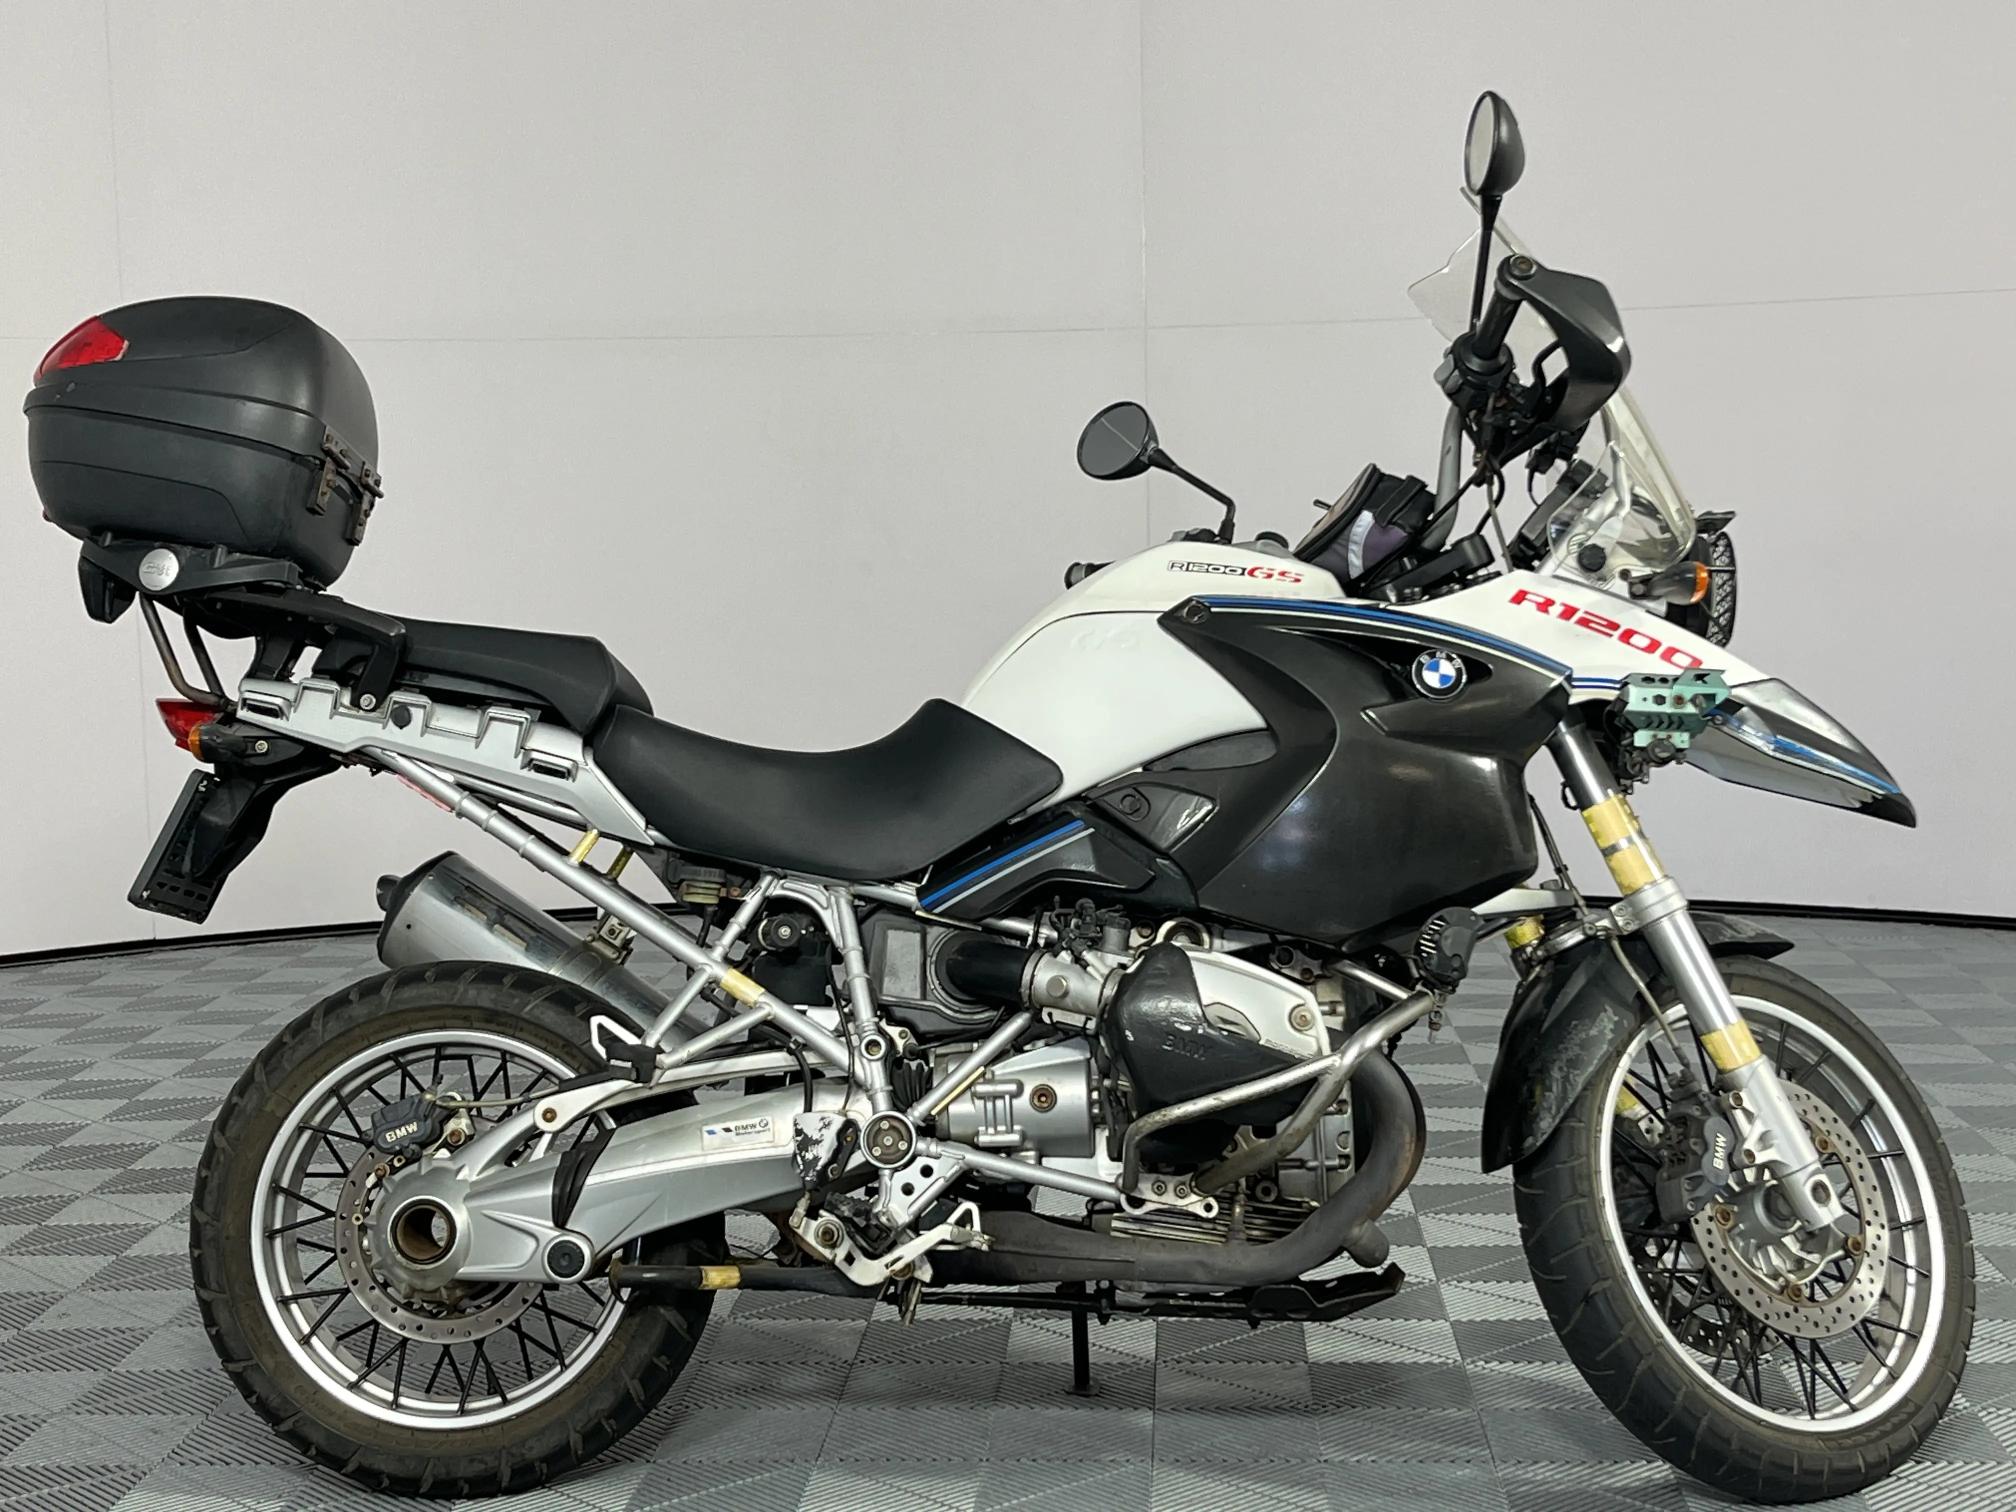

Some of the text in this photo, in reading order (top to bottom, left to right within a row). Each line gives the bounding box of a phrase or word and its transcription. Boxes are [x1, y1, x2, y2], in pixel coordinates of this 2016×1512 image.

[1508, 588, 1703, 670] R1200
[1420, 651, 1461, 669] BMW
[384, 1121, 418, 1143] BMW
[1712, 1132, 1727, 1170] BMW
